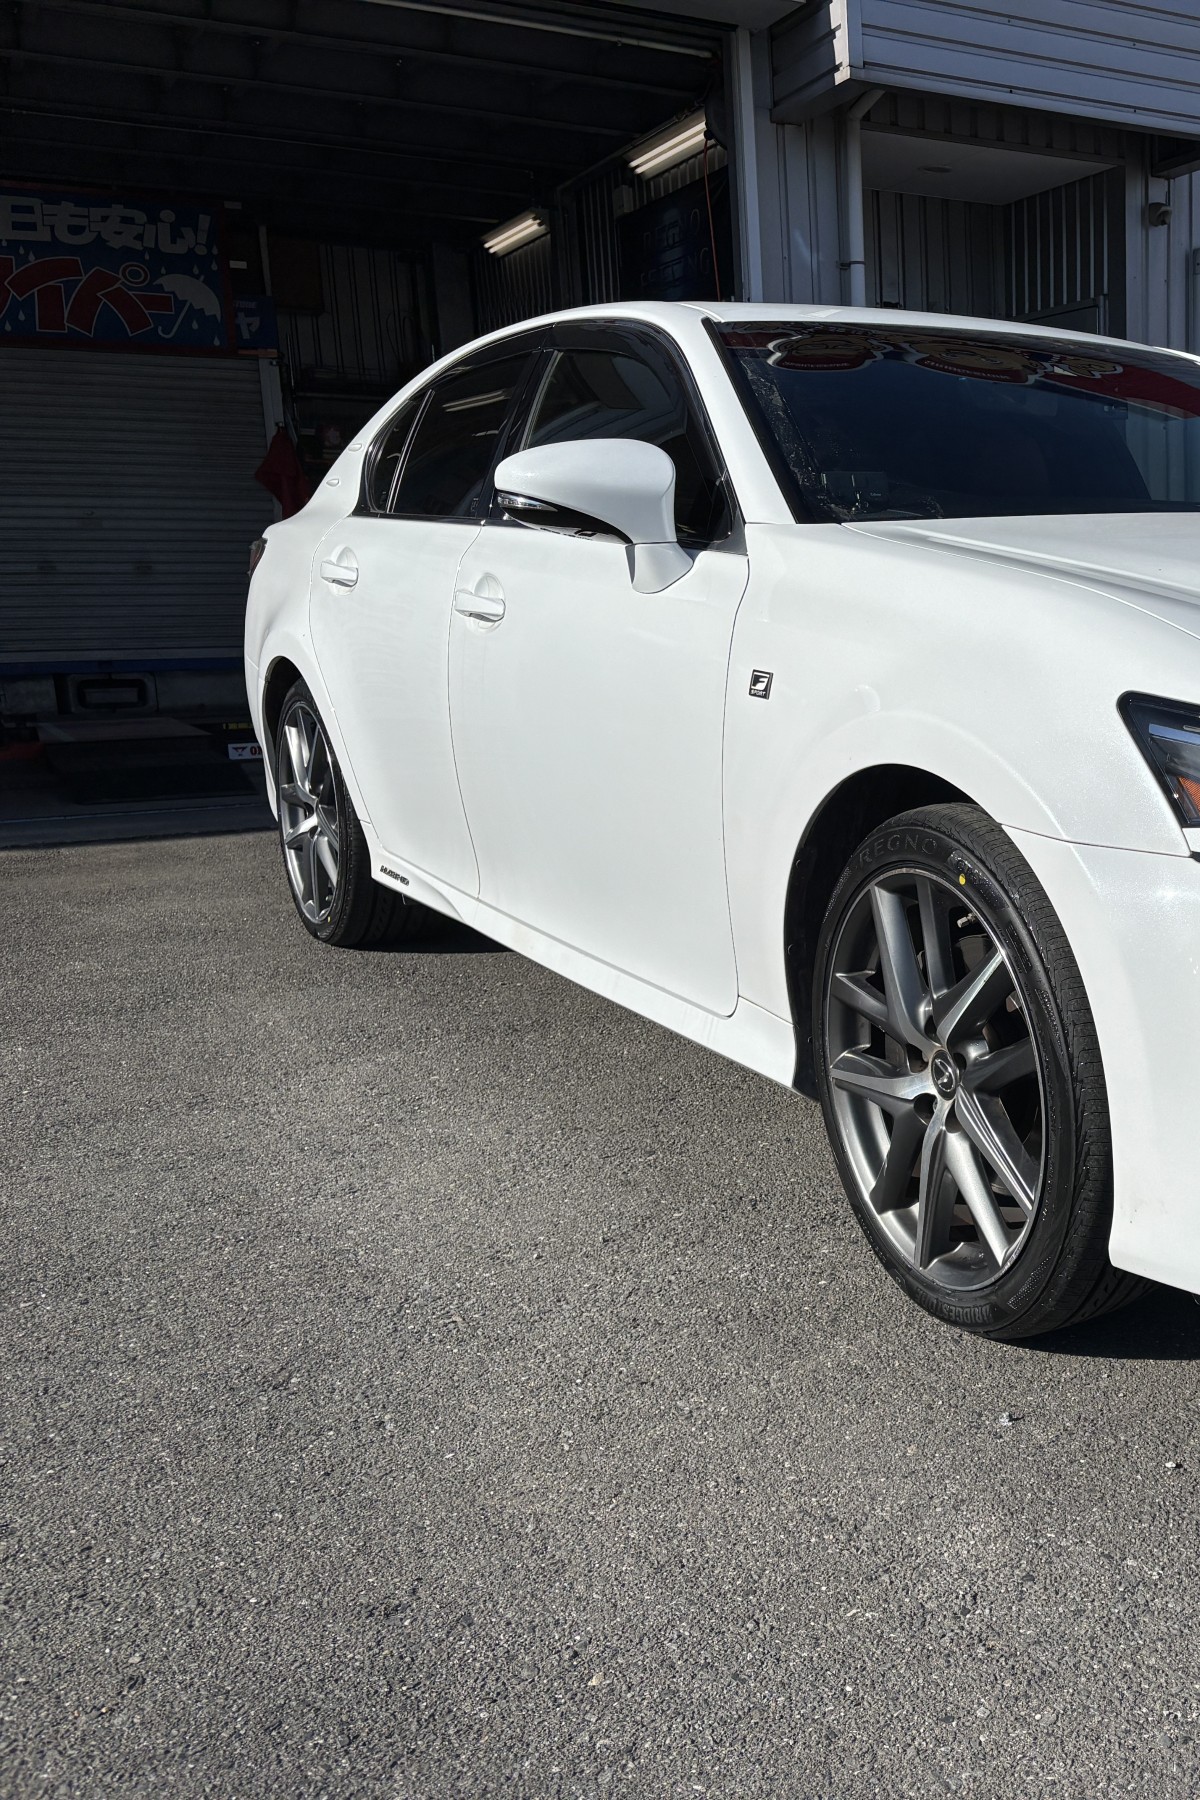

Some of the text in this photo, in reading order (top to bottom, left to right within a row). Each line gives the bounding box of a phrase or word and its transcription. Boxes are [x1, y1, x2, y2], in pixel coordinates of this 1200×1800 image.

[0, 256, 175, 337] イパー
[858, 833, 938, 868] REGNO
